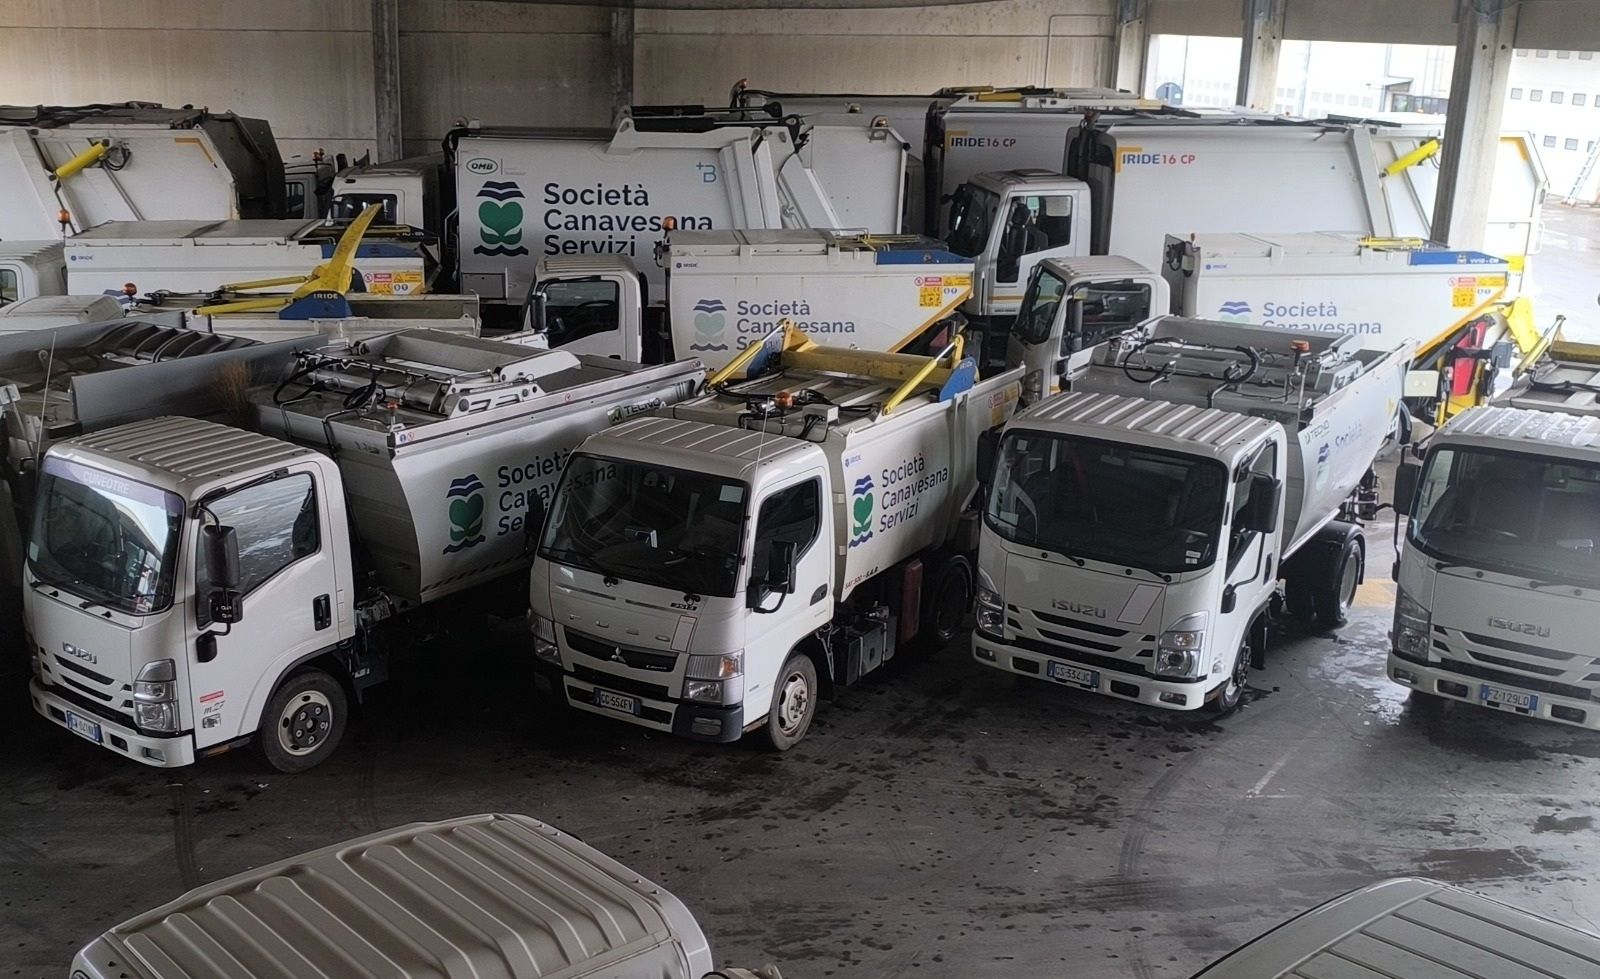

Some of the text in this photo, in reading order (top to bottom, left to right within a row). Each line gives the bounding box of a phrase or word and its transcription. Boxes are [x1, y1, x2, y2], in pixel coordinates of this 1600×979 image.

[1002, 138, 1017, 149] CP
[471, 162, 494, 170] OMB
[1181, 154, 1196, 165] CP
[543, 182, 650, 206] Società
[543, 234, 636, 257] Servizi
[736, 299, 811, 316] Società
[1262, 301, 1338, 317] Società
[881, 452, 925, 488] Società
[881, 466, 949, 510] Canavesana
[879, 498, 919, 533] Servizi
[1051, 598, 1106, 619] ISUZU
[1488, 615, 1550, 638] ISUZU
